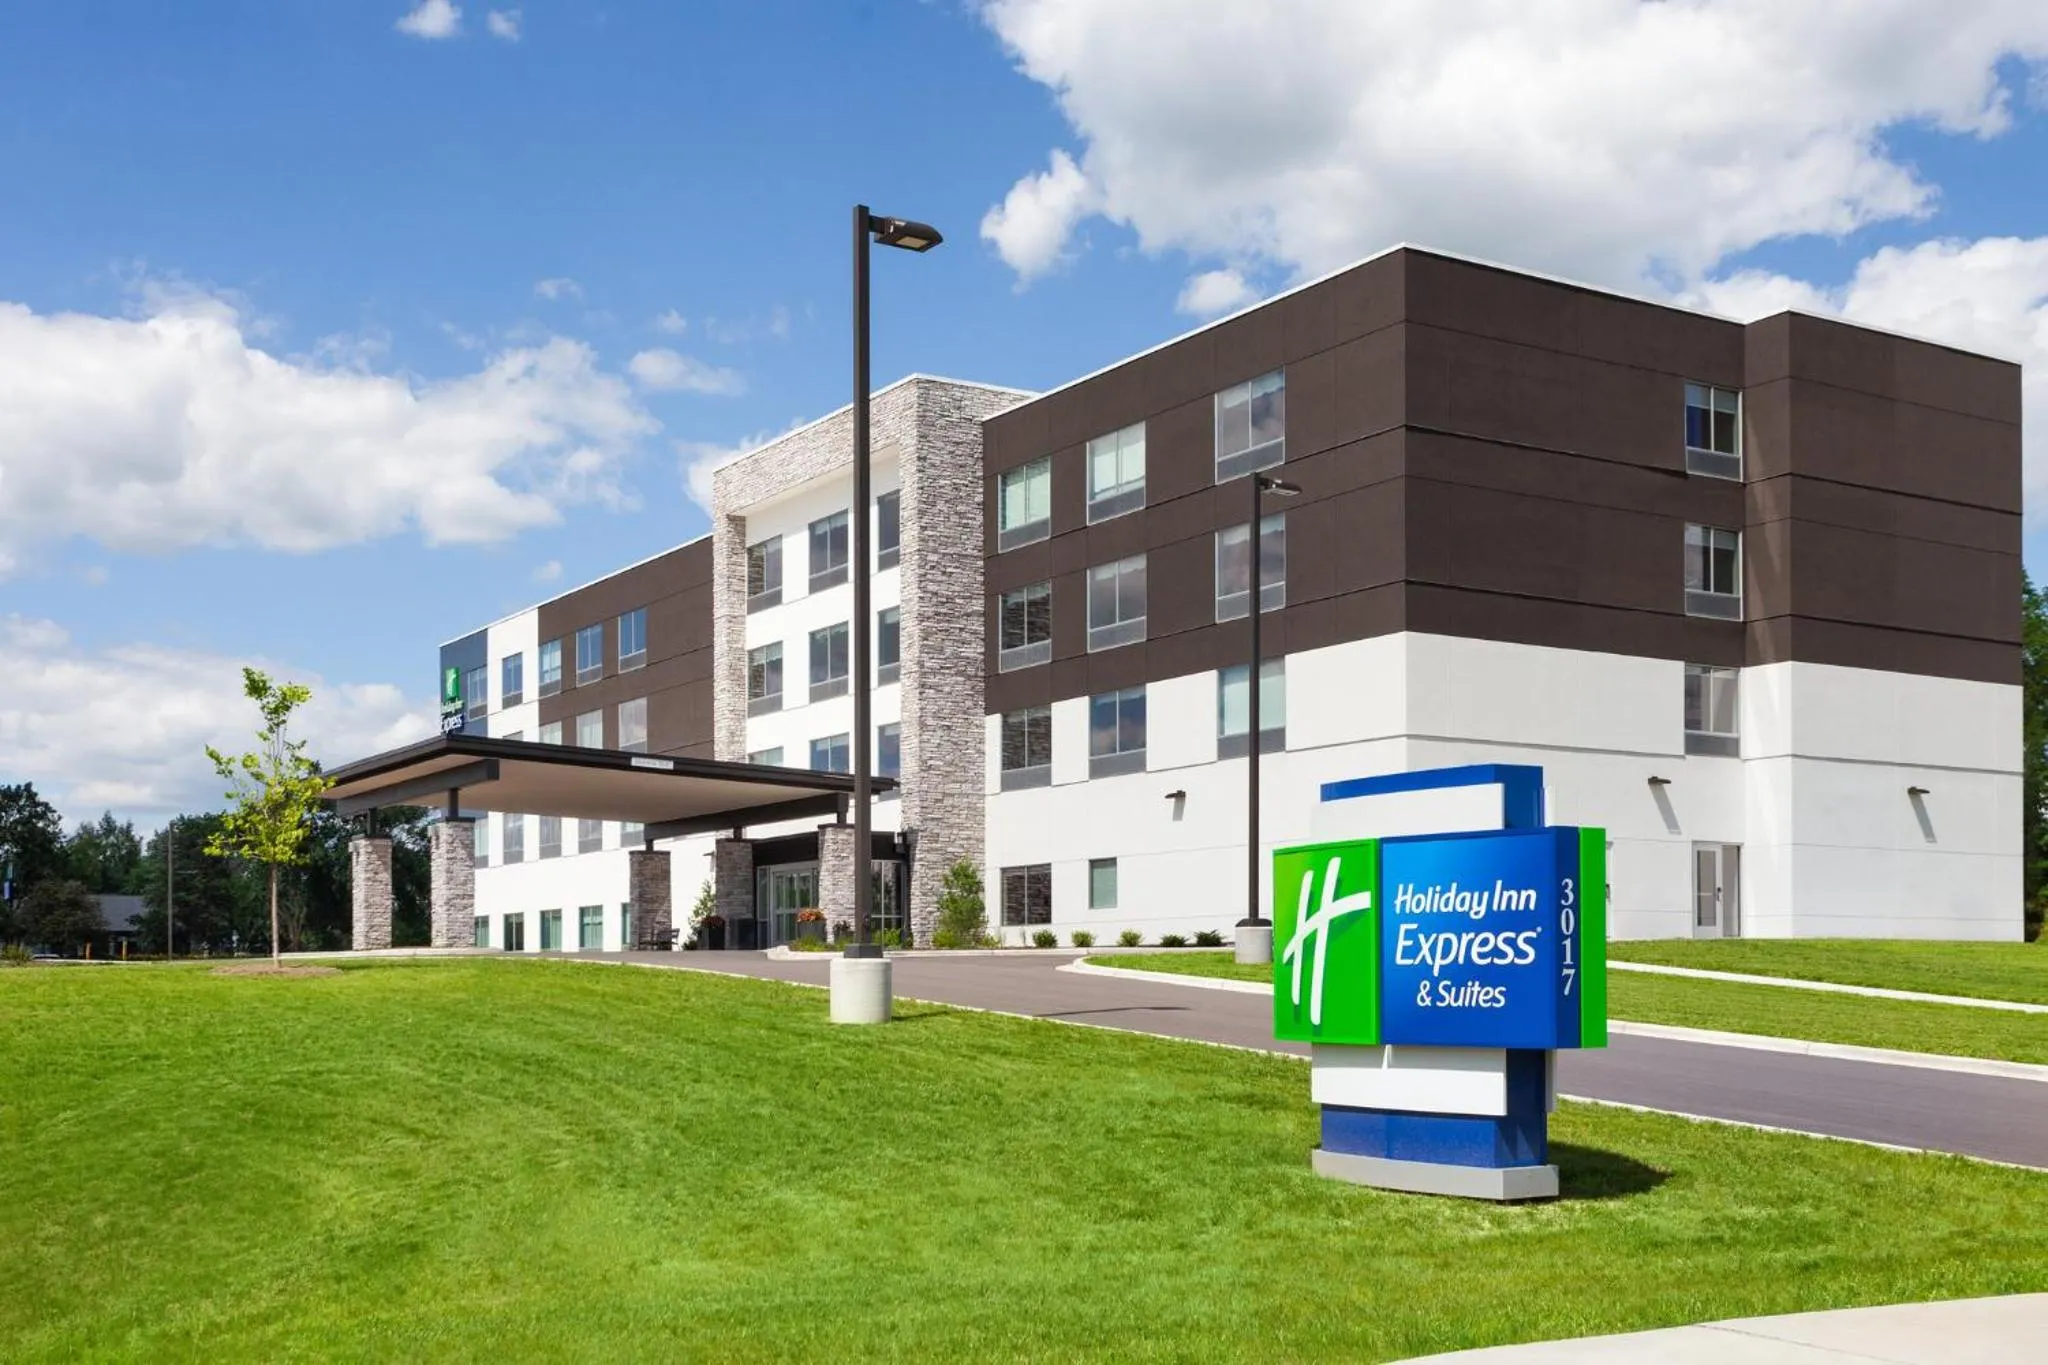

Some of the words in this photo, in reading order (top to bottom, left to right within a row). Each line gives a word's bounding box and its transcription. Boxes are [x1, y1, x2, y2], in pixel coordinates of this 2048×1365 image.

[1394, 882, 1489, 920] Holiday
[1492, 879, 1537, 912] Inn
[1394, 923, 1537, 977] Express
[1560, 878, 1576, 996] 3017
[1416, 980, 1432, 1007] &
[1436, 980, 1507, 1008] Suites
